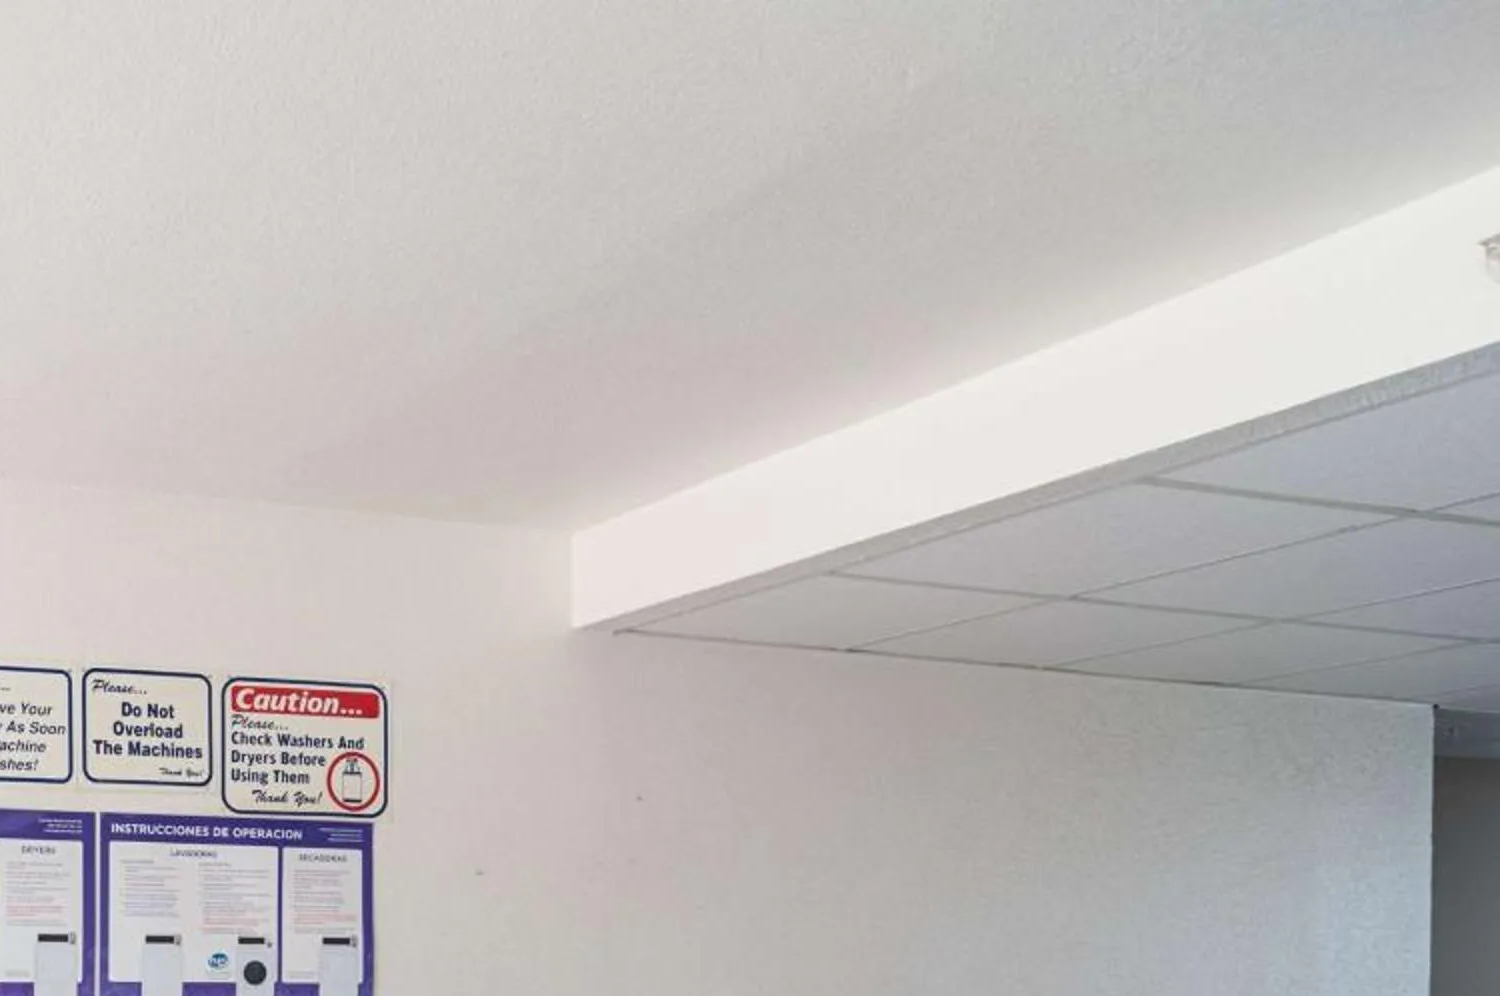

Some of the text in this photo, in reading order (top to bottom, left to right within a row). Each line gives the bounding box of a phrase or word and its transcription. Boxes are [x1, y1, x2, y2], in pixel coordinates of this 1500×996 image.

[21, 702, 52, 716] Your
[236, 688, 363, 716] Caution...
[121, 702, 174, 719] Do Not
[7, 721, 26, 733] As
[30, 722, 65, 735] Soon
[113, 721, 183, 739] Overload
[231, 732, 364, 750] Check Washers And
[93, 740, 202, 759] The Machines
[231, 752, 326, 767] Dryers Before
[231, 769, 310, 785] Using Them
[252, 789, 289, 804] Thank
[111, 824, 302, 840] INSTRUCCIONES DE OPERACION
